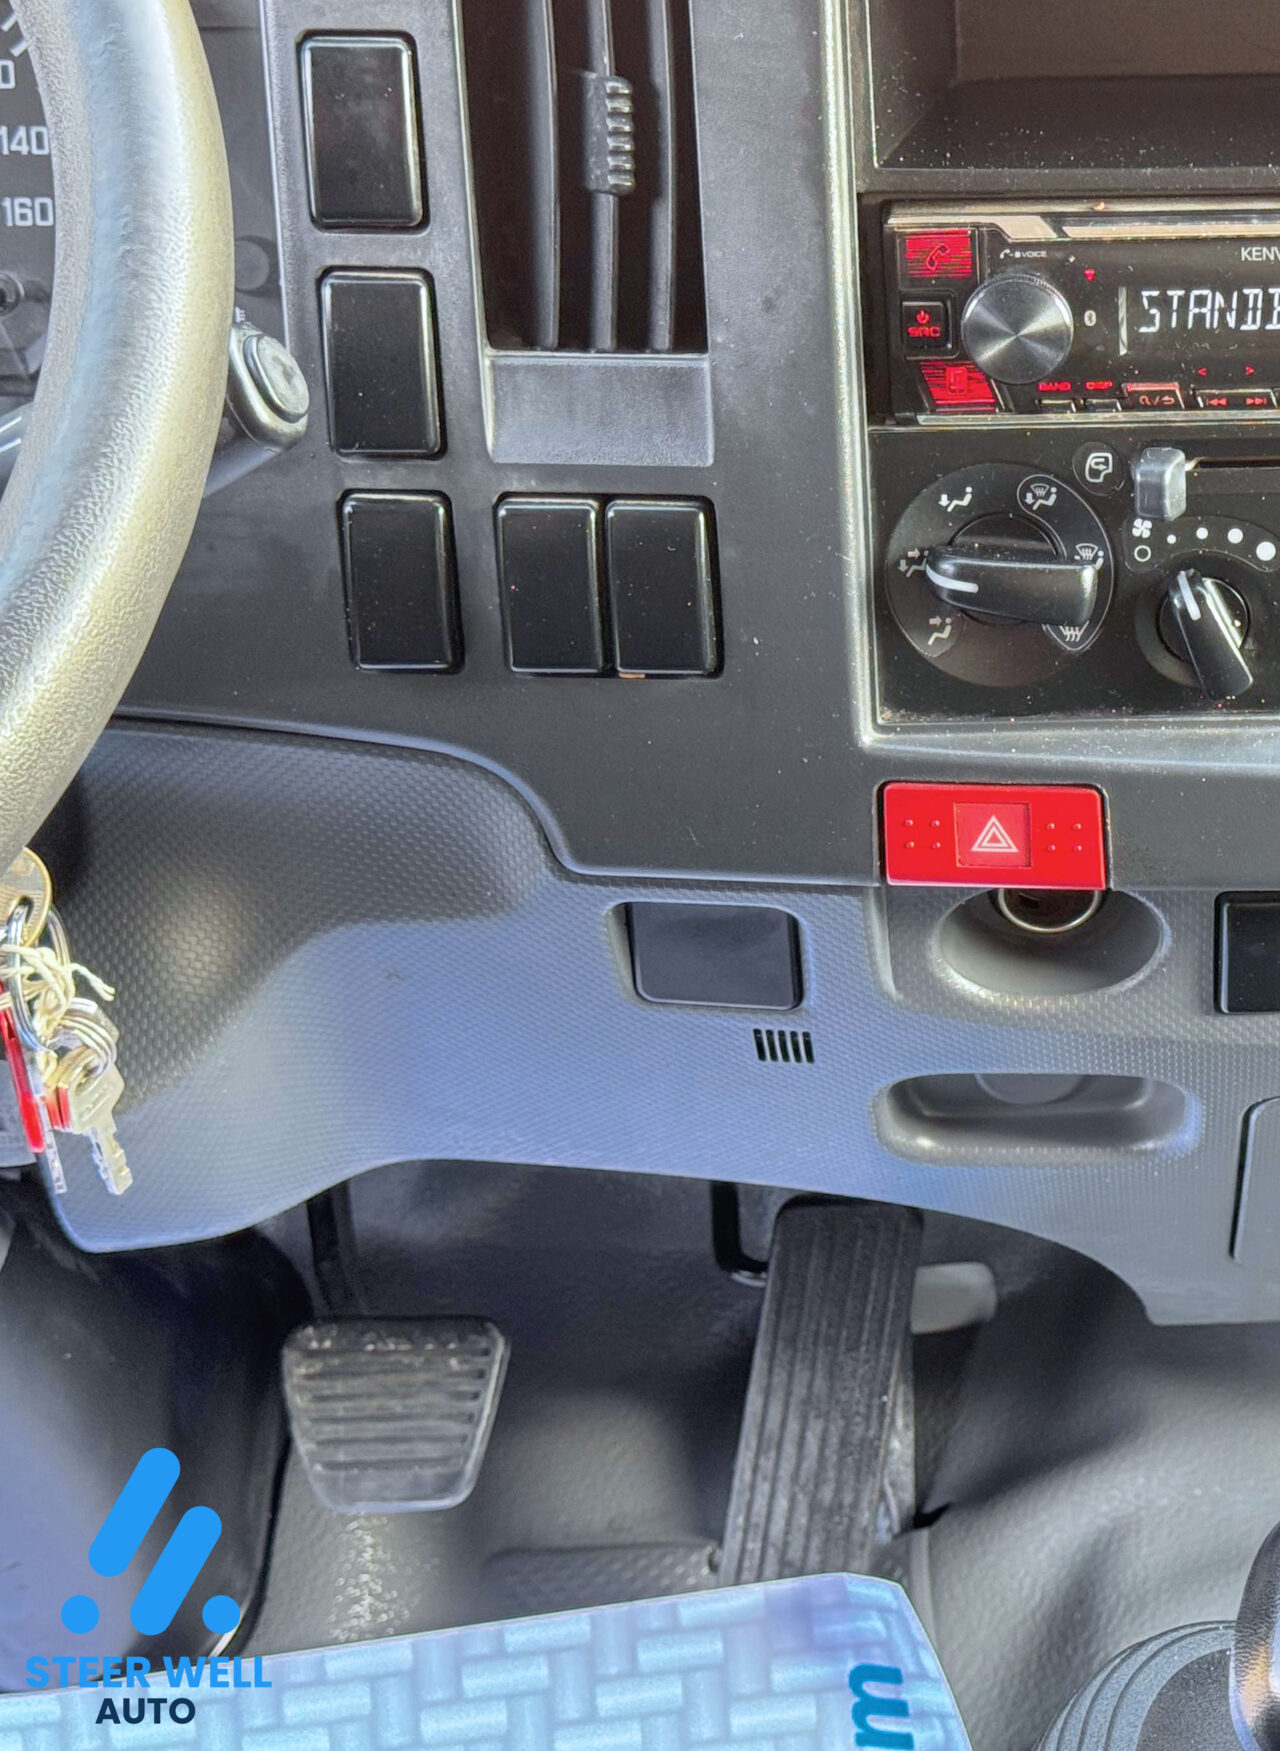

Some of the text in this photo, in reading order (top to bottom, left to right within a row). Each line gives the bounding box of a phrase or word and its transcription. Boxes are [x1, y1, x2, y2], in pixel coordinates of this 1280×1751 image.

[0, 125, 49, 156] 140
[2, 197, 54, 227] 160
[906, 325, 941, 338] SRC
